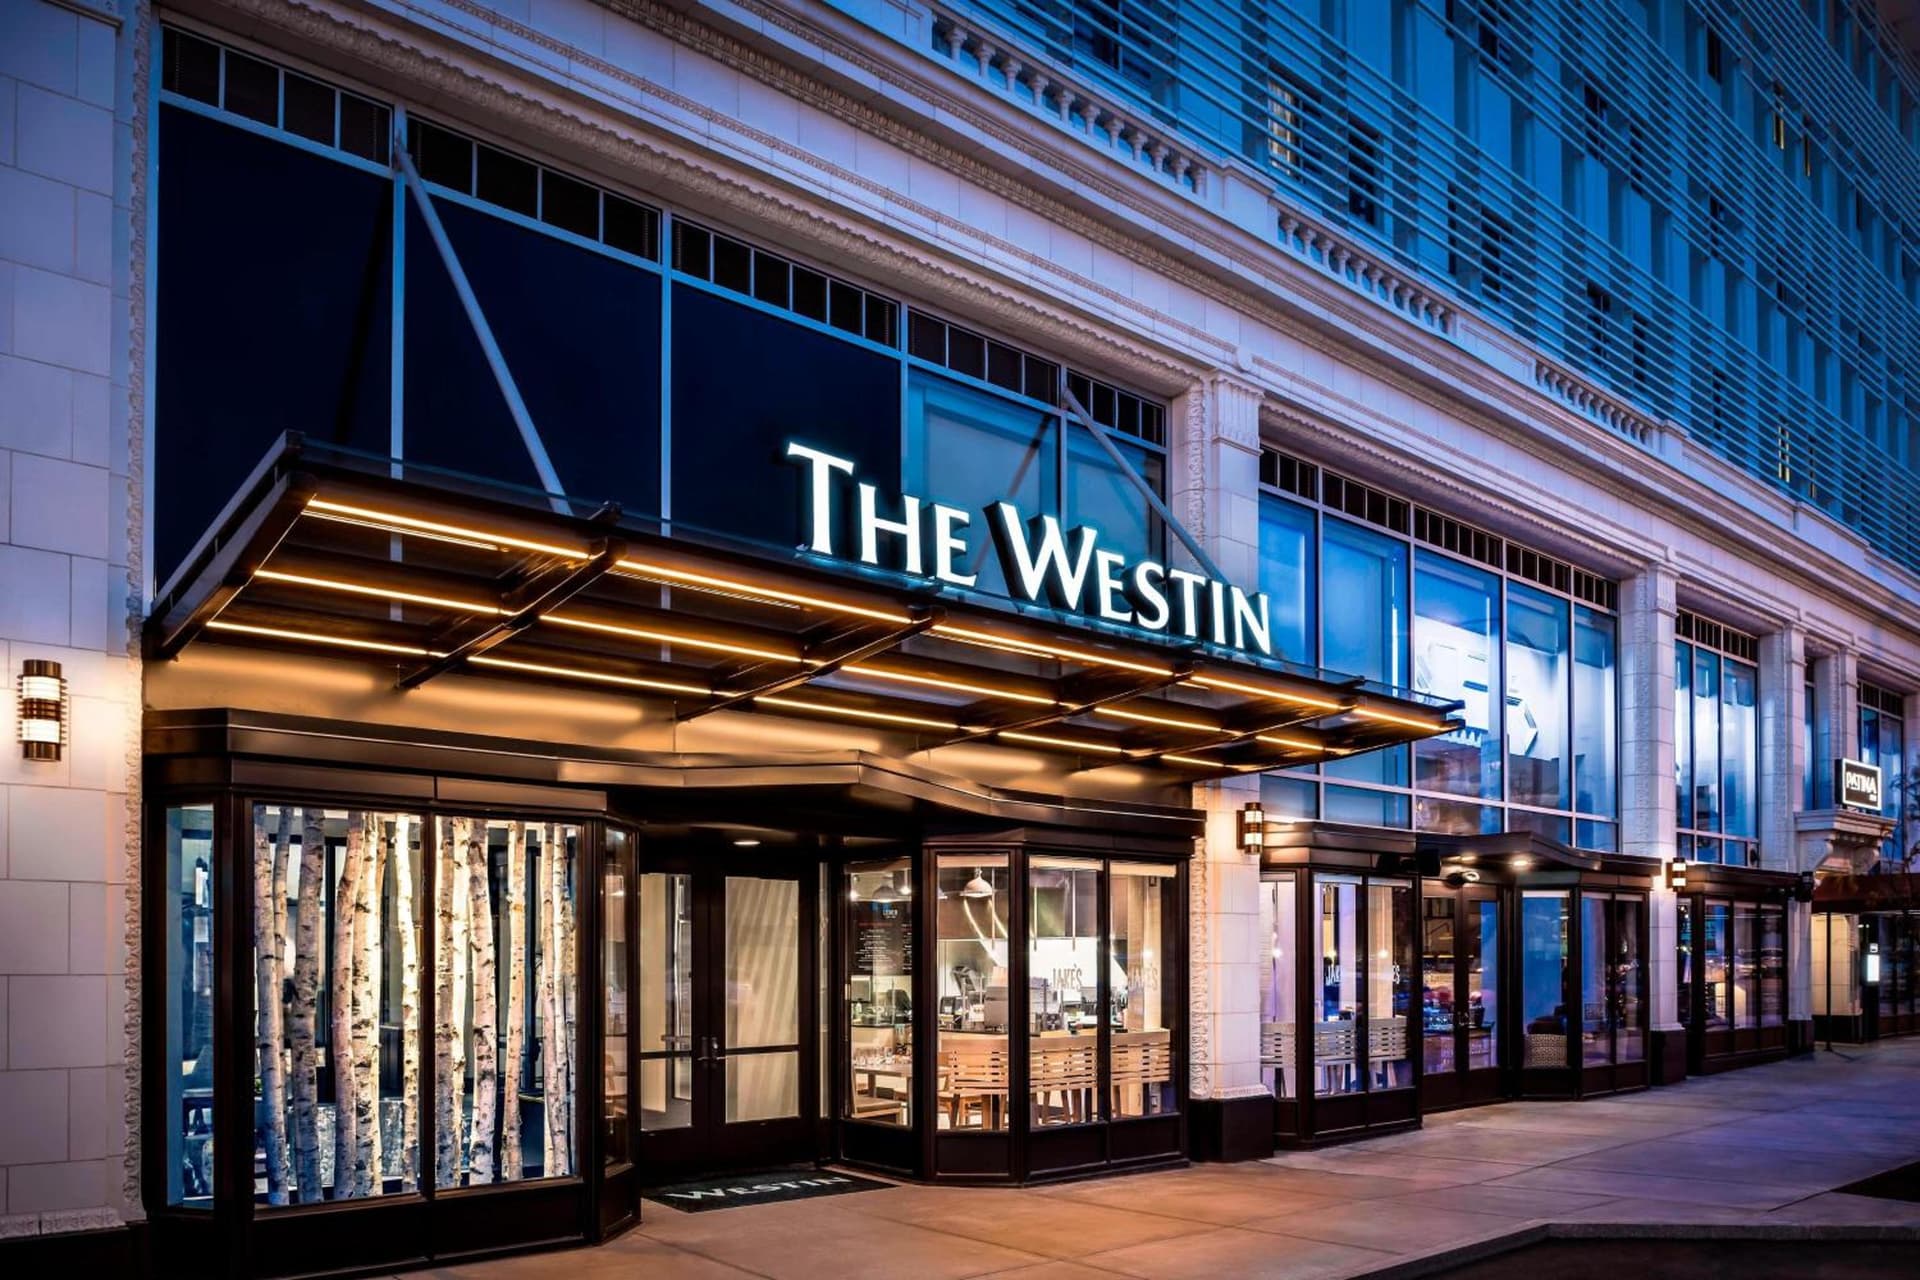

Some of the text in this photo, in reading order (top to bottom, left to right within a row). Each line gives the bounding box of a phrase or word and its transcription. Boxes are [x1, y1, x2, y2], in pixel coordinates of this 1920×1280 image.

[787, 442, 1272, 656] THE WESTIN
[665, 1176, 853, 1200] WESTIN
